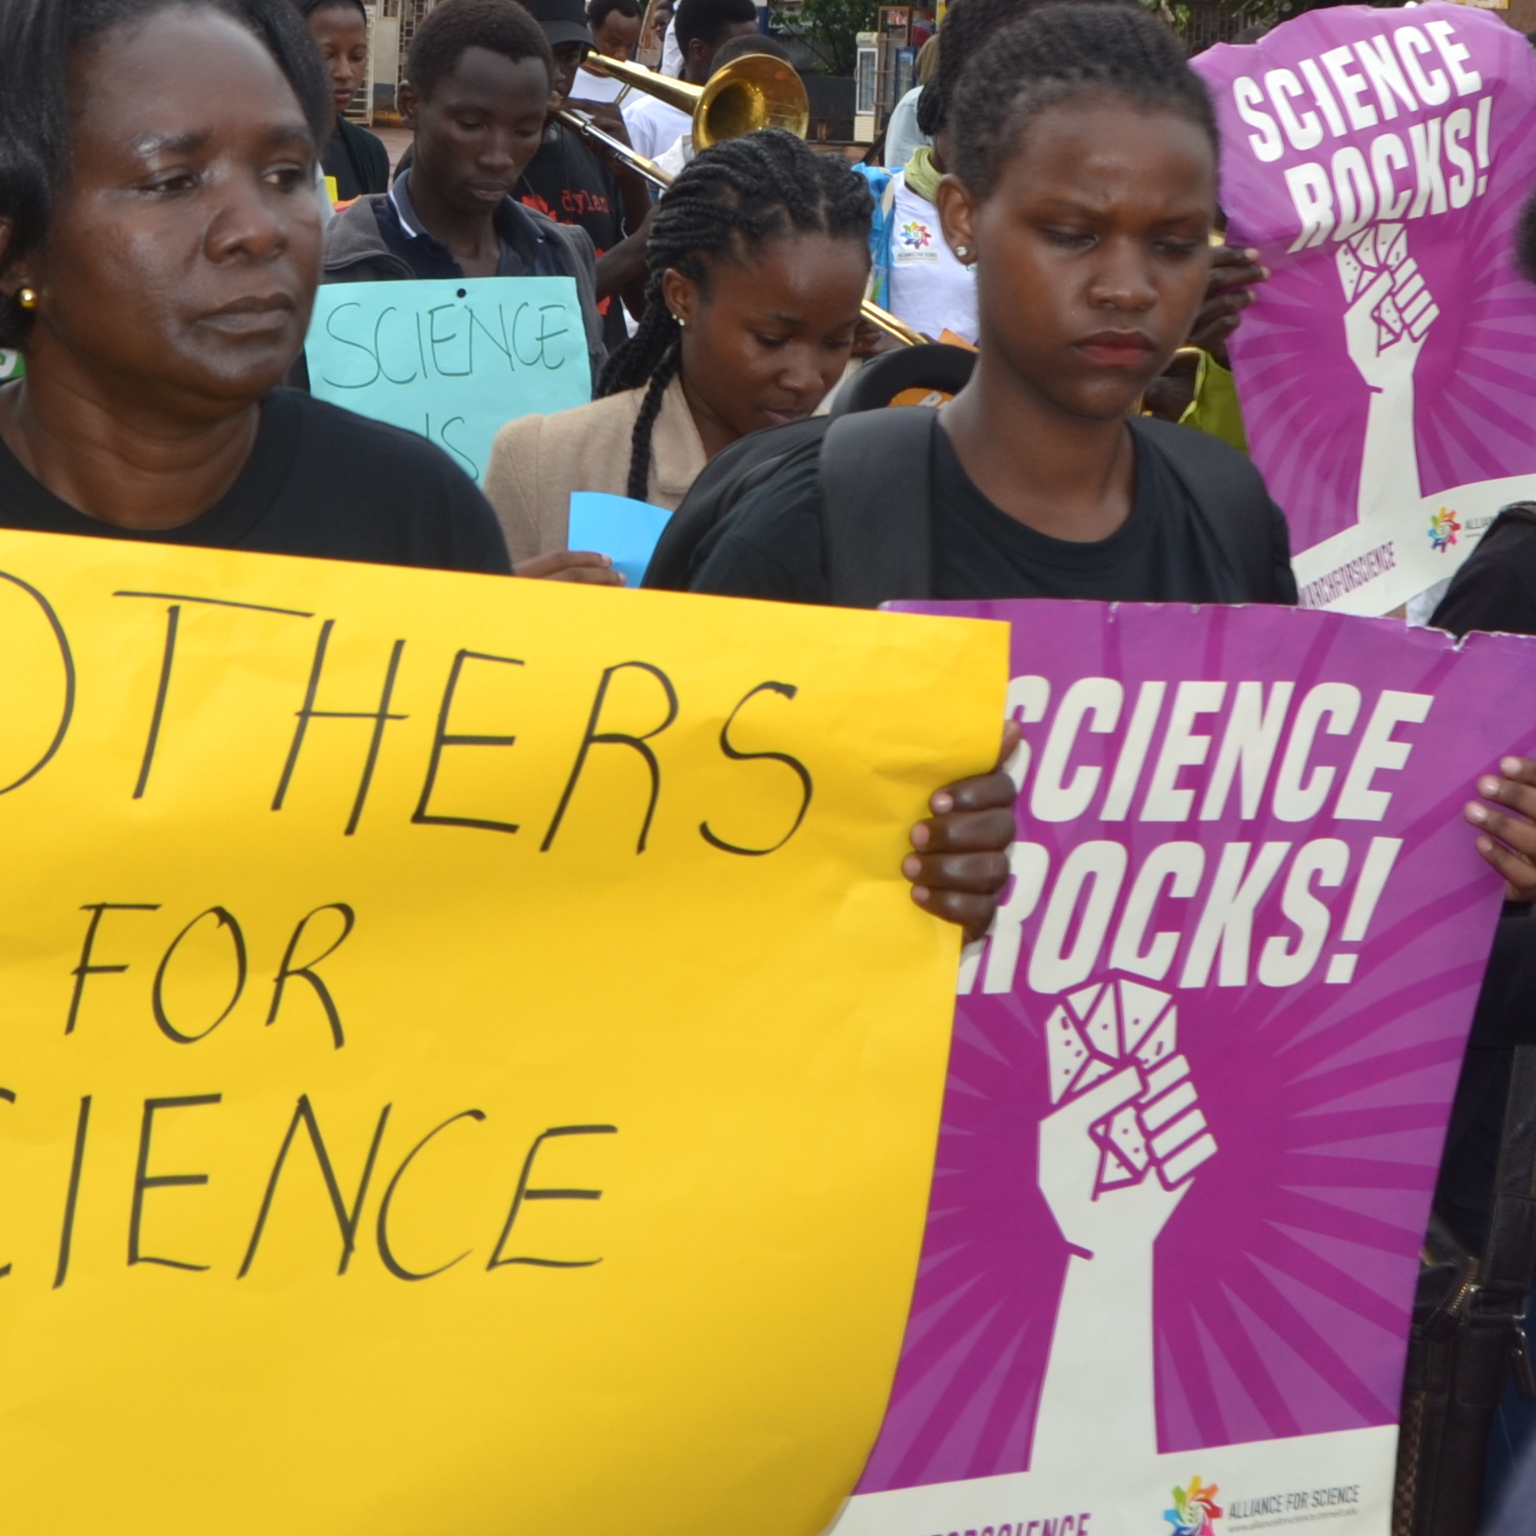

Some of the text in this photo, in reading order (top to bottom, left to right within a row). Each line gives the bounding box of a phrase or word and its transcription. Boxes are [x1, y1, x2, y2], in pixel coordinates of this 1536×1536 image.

[1232, 19, 1484, 163] SCIENCE
[1284, 96, 1492, 255] ROCKS!
[322, 302, 569, 389] SCIENCE
[1005, 675, 1434, 822] SCIENCE
[64, 900, 357, 1052] FOR
[955, 836, 1403, 996] ROCKS!
[1228, 1484, 1361, 1521] ALLIANCE FOR SCIENCE
